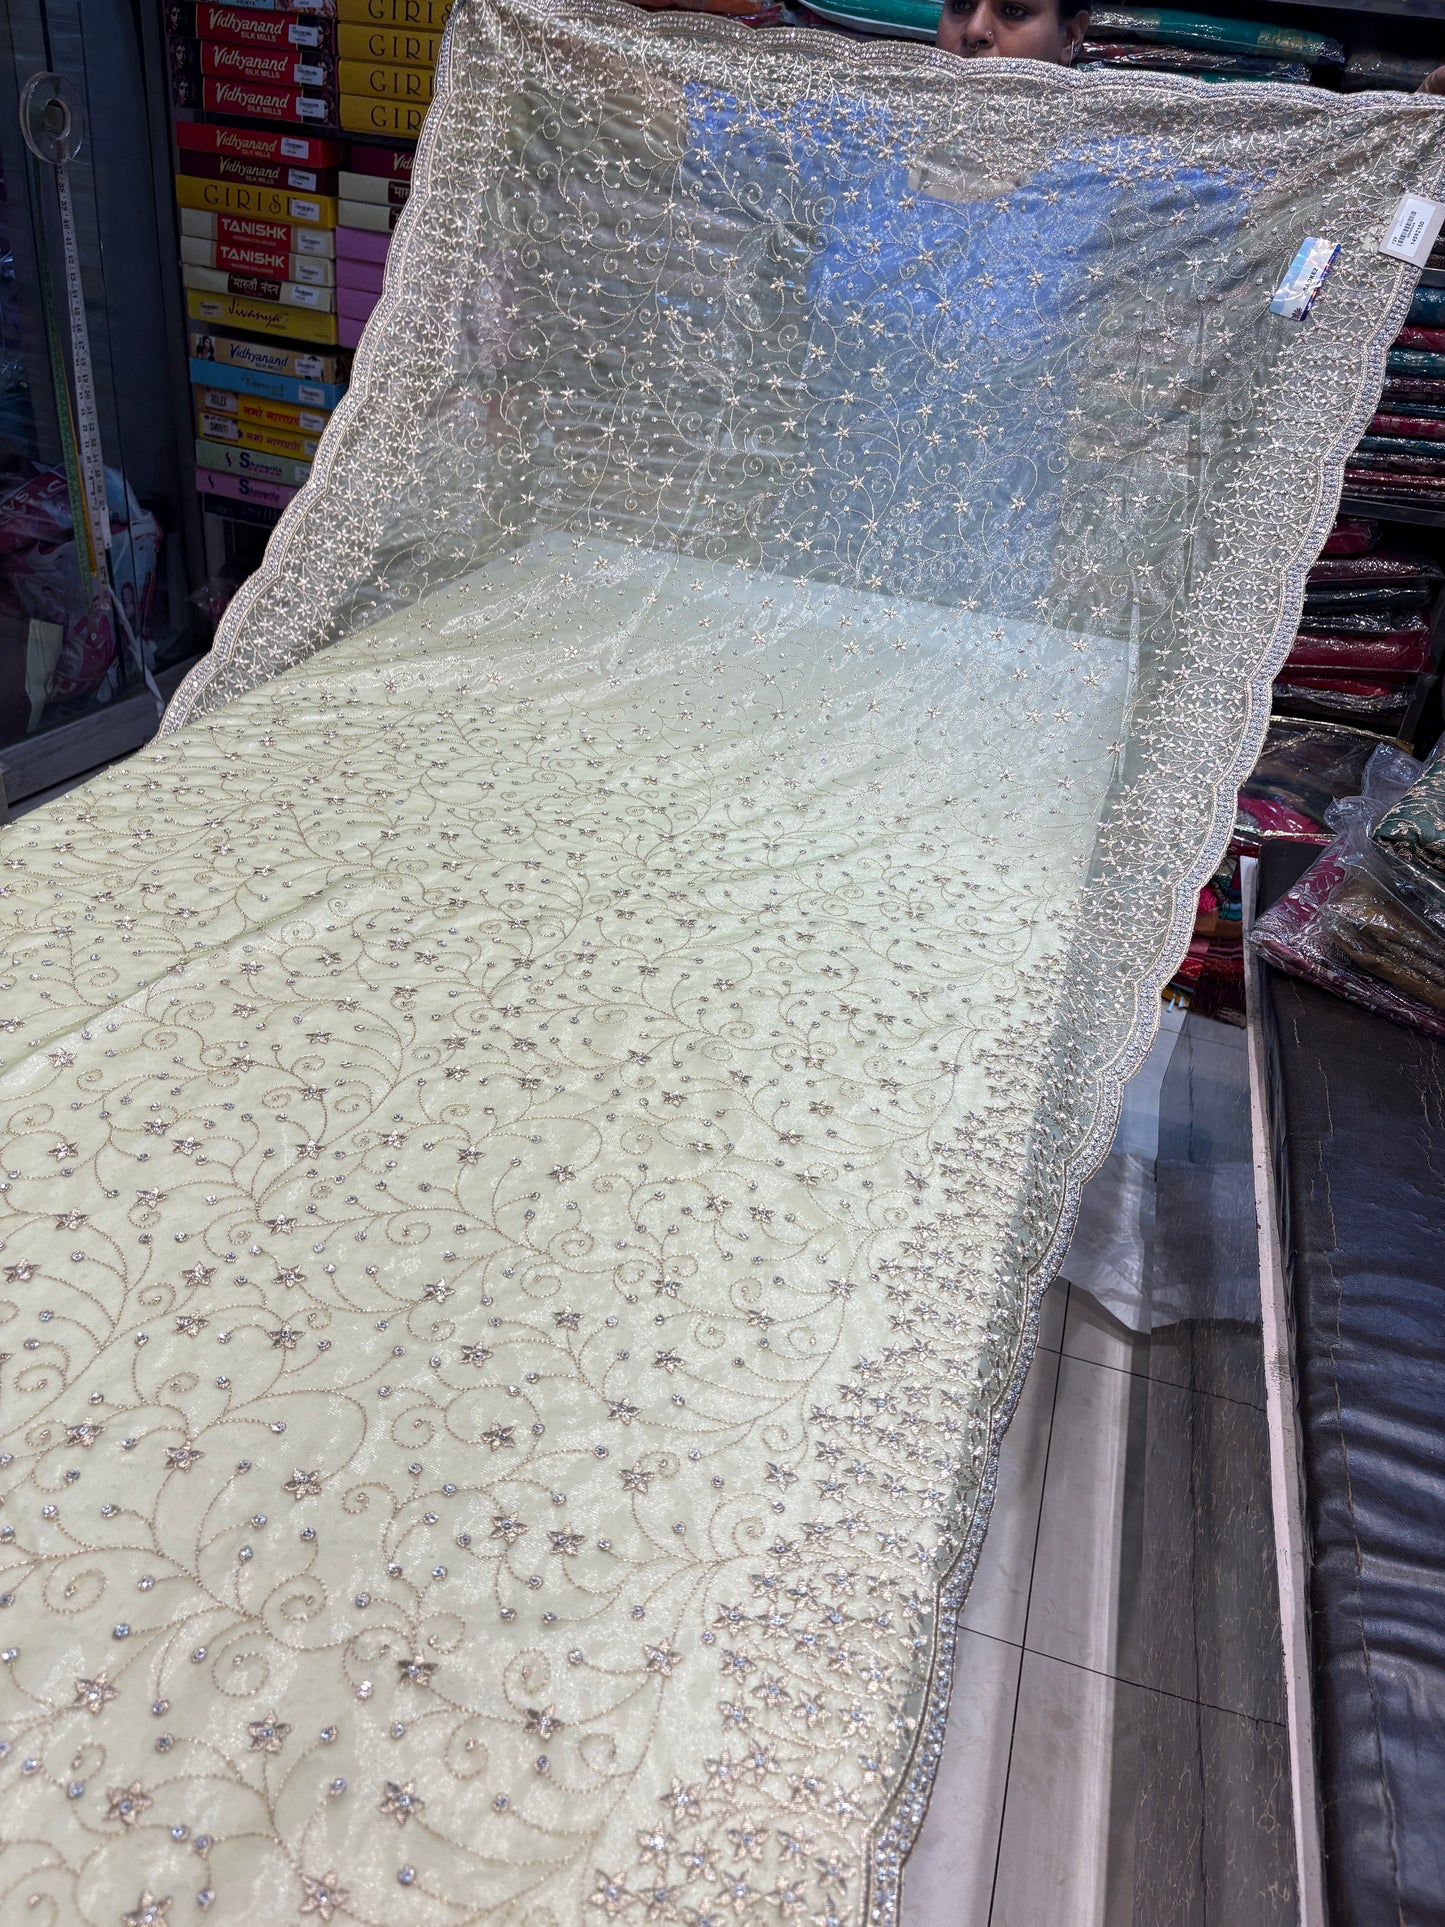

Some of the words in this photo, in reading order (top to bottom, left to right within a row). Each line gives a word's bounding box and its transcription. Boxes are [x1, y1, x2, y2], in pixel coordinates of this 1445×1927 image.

[208, 8, 285, 35] Vidhyanand
[241, 31, 258, 41] SILK
[259, 32, 277, 43] MILLS
[213, 45, 289, 72] Vidhyanand
[245, 68, 259, 77] SILK
[260, 69, 280, 79] MILLS
[216, 82, 290, 109] Vidhyanand
[247, 104, 261, 114] SILK
[262, 105, 282, 117] MILLS
[216, 129, 278, 152] Vidhyanand
[218, 155, 281, 178] Vidhyanand
[221, 218, 288, 241] TANISHK
[220, 246, 286, 269] TANISHK
[230, 343, 289, 367] Vidhyanand
